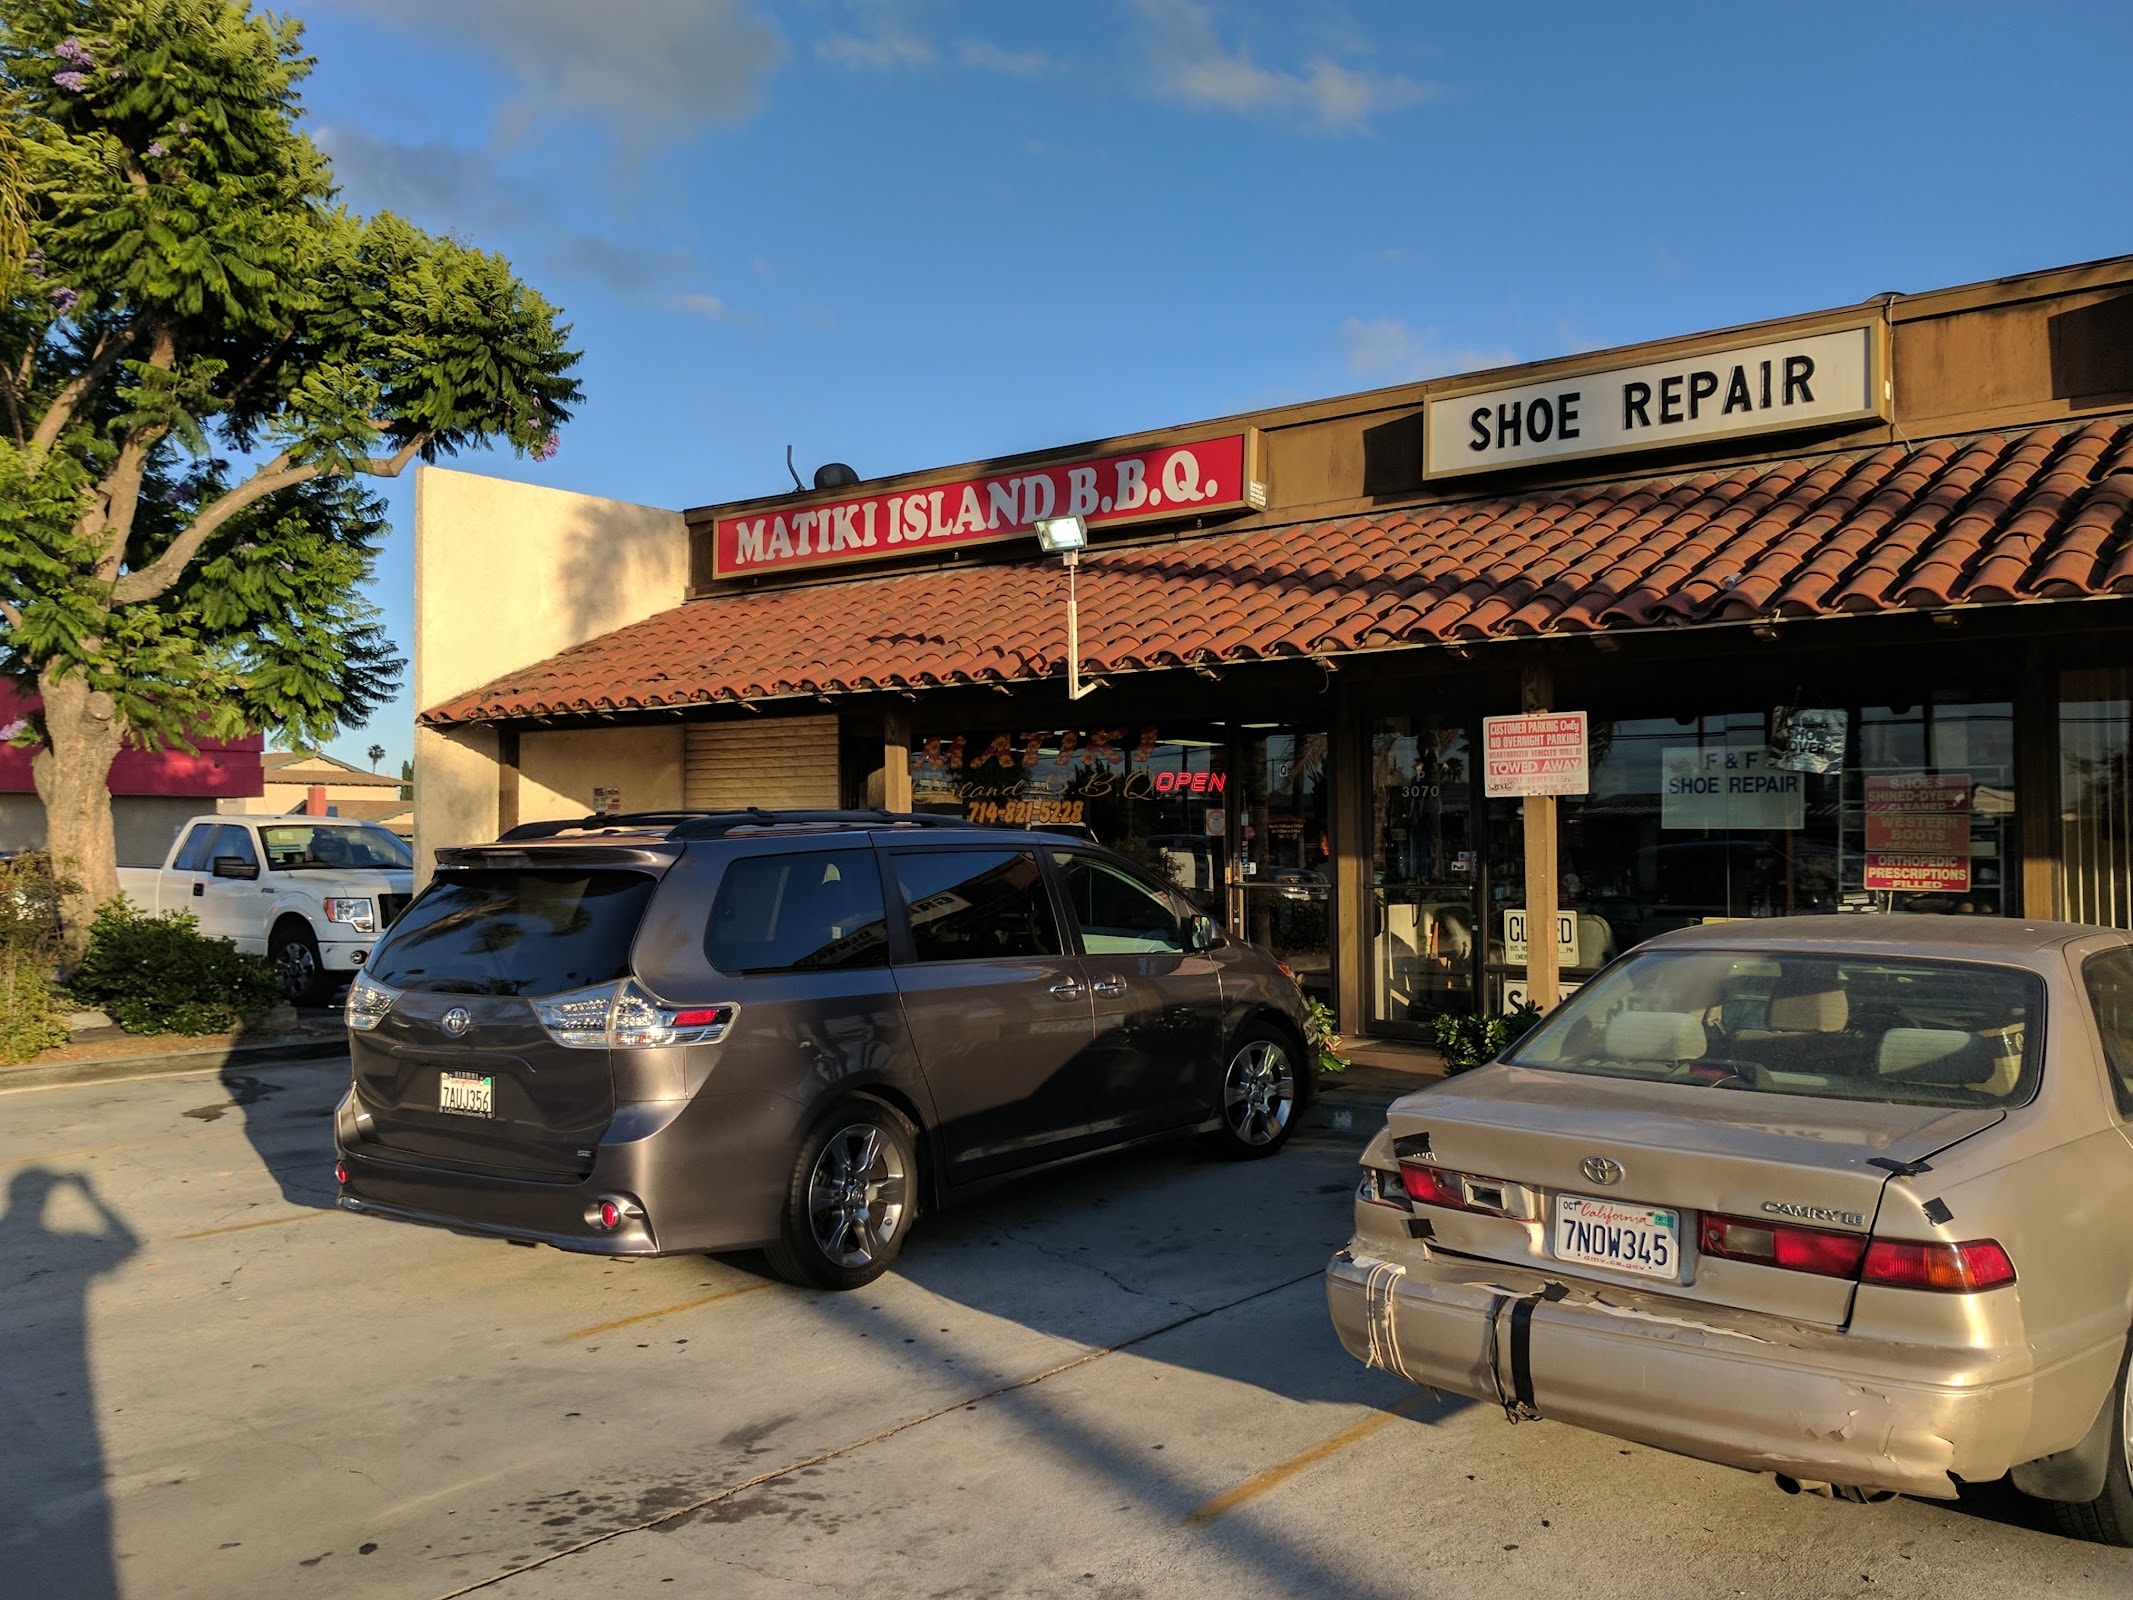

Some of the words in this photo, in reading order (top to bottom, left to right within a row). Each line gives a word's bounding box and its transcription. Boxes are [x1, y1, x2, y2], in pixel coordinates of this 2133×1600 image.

[1469, 392, 1581, 451] SHOE
[1623, 355, 1816, 430] REPAIR
[735, 499, 879, 565] MATIKI
[887, 473, 1055, 544] ISLAND
[1067, 448, 1219, 516] B.B.Q.
[1490, 721, 1527, 735] CUSTOMER
[1528, 720, 1558, 733] PARKING
[1560, 719, 1579, 732] Only
[912, 727, 1158, 771] MATIKI
[1490, 736, 1501, 748] NO
[1503, 734, 1544, 747] OVERNIGHT
[1546, 733, 1580, 745] PARKING
[1491, 761, 1538, 774] TOWED
[1542, 759, 1579, 772] AWAY
[1706, 753, 1717, 769] F
[1725, 753, 1738, 769] &
[1746, 752, 1758, 768] F
[1156, 771, 1227, 794] OPEN
[1401, 785, 1439, 797] 3070
[1669, 777, 1719, 794] SHOE
[1729, 776, 1798, 793] REPAIR
[1890, 778, 1945, 789] SHOES
[967, 801, 1084, 824] 714-821-5228
[1881, 816, 1957, 829] WESTERN
[1891, 829, 1945, 840] BOOTS
[1878, 856, 1957, 867] ORTHOPEDIC
[1868, 867, 1966, 880] PRESCRIPTIONS
[443, 1086, 490, 1111] 7AUJ356
[1563, 1201, 1577, 1211] OCT
[1580, 1202, 1655, 1227] California
[1761, 1201, 1839, 1221] CAMRY
[1563, 1219, 1668, 1266] 7NOW345
[1583, 1255, 1646, 1271] dmv.ca.gov
